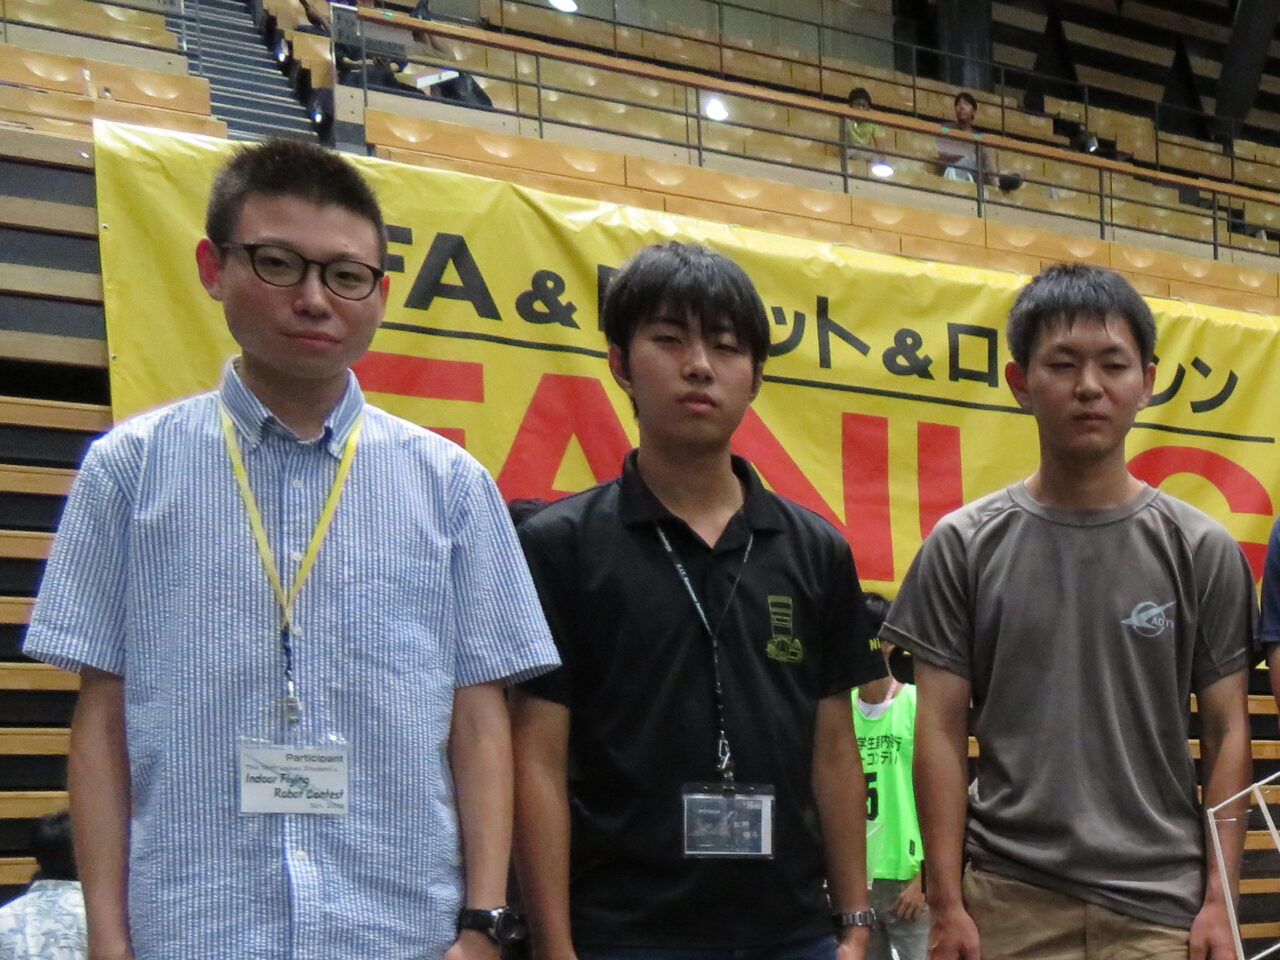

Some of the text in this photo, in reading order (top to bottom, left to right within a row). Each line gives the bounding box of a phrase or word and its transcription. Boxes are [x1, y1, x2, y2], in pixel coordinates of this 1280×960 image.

[515, 269, 580, 329] &
[882, 328, 935, 380] &
[285, 752, 344, 763] Participant
[245, 772, 310, 788] Indoor Flying
[273, 787, 344, 800] Robot Contest
